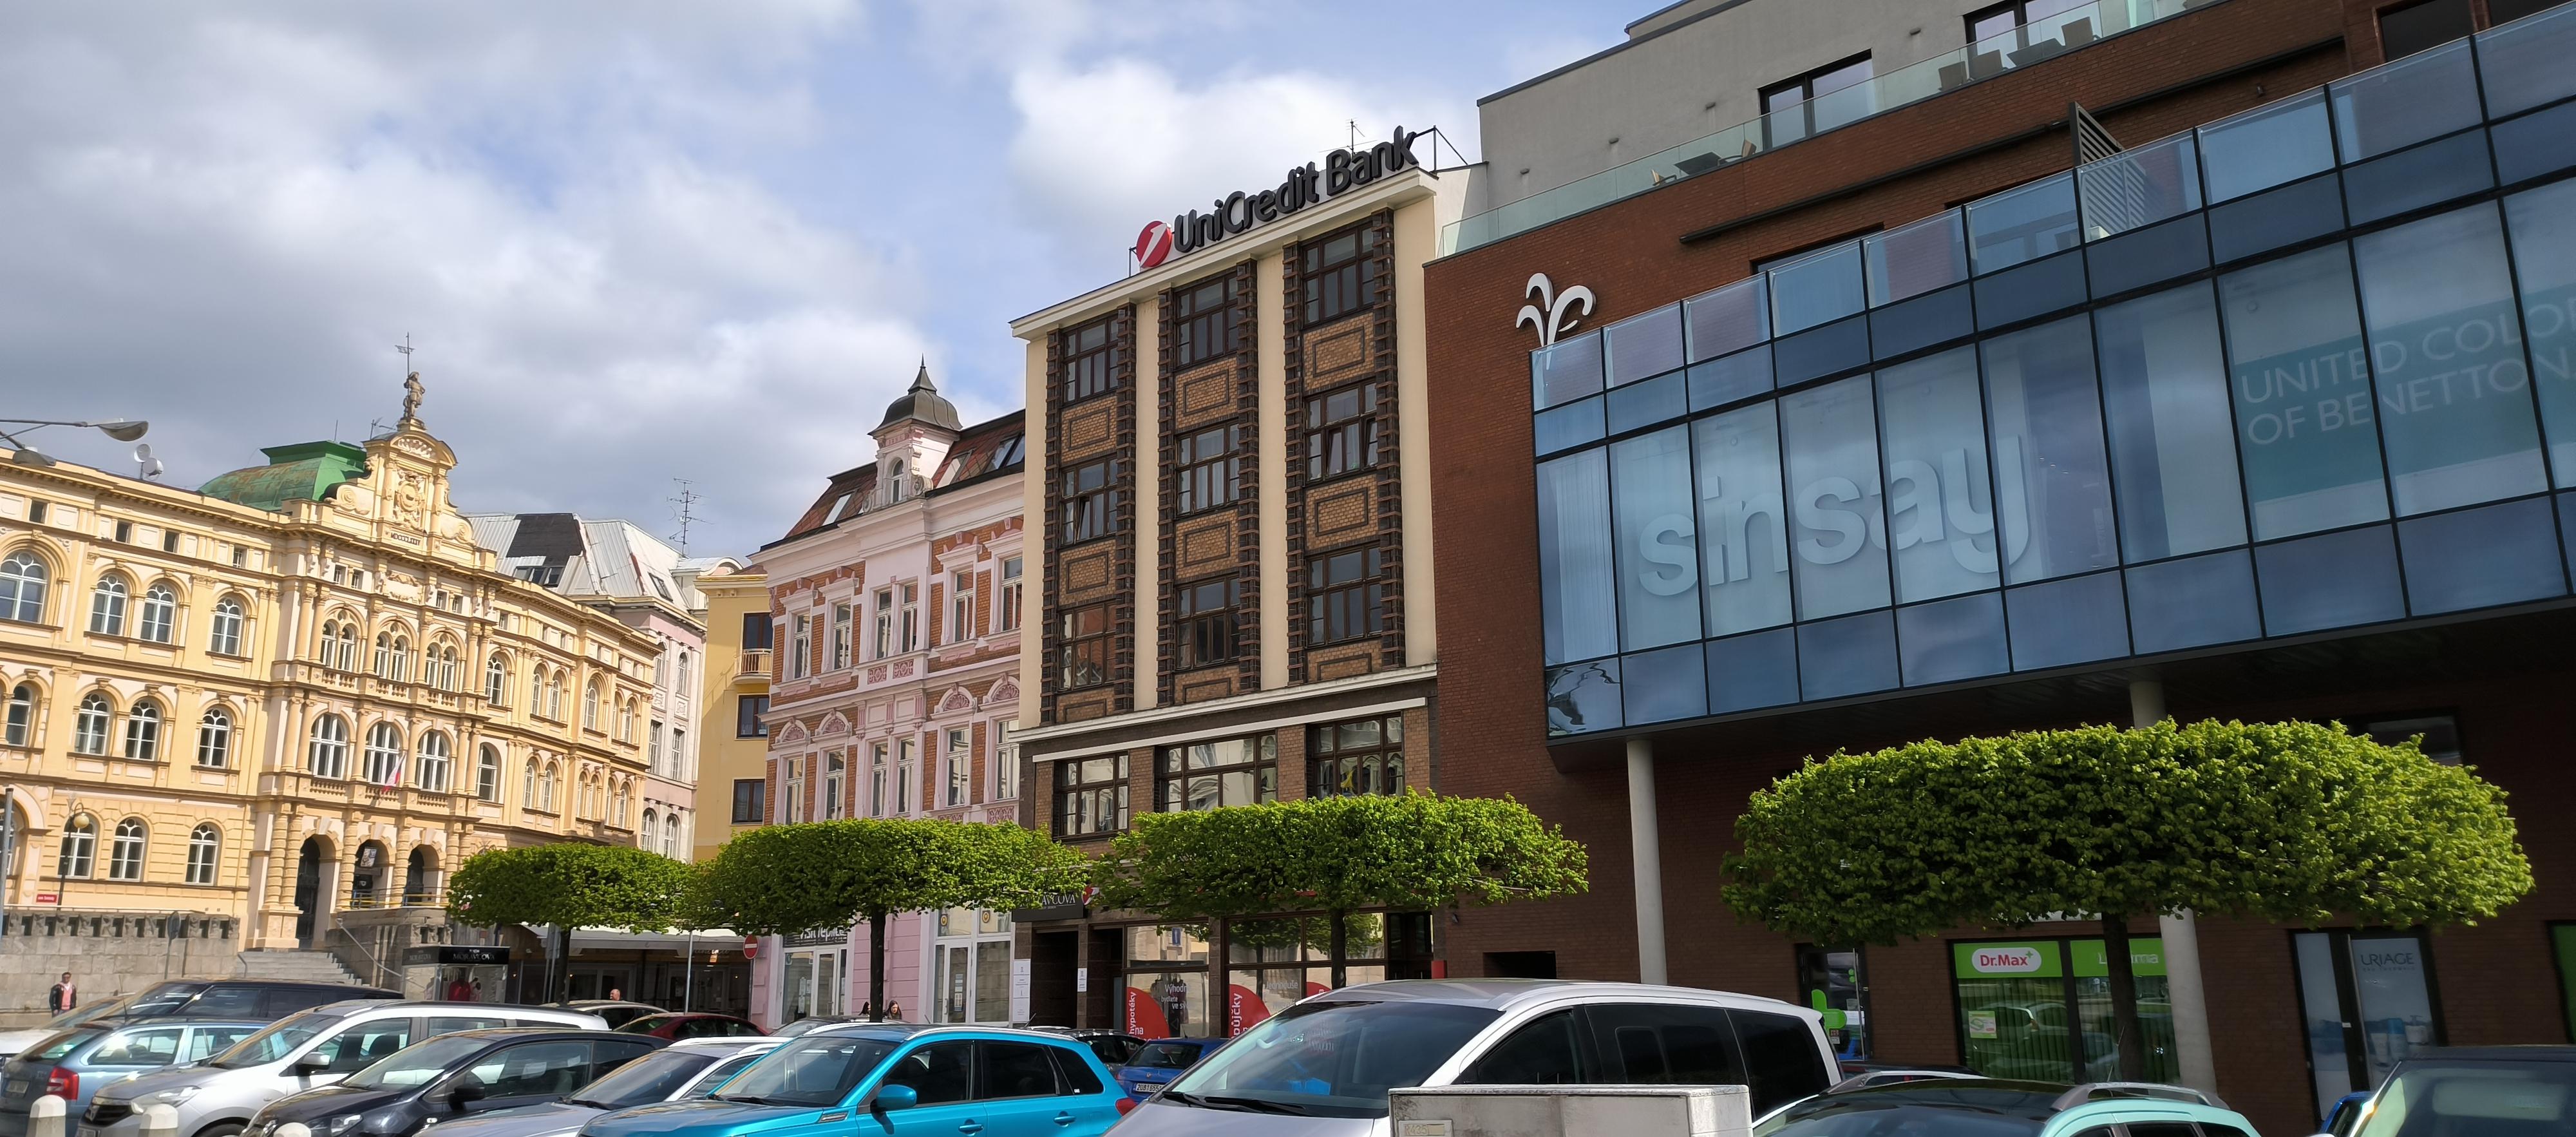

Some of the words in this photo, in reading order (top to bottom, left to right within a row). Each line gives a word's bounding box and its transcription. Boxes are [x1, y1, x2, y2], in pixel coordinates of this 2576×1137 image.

[1174, 160, 1319, 253] UniCredit
[1326, 125, 1419, 196] Bank
[2242, 340, 2407, 404] UNITED
[2248, 405, 2306, 445] OF
[2318, 345, 2570, 433] BENETTON
[1639, 434, 2031, 596] sinsay
[1980, 954, 2029, 967] Dr.Max
[2360, 953, 2415, 966] URIAGE
[1128, 991, 1137, 1035] hypotéky
[1135, 1027, 1144, 1035] na
